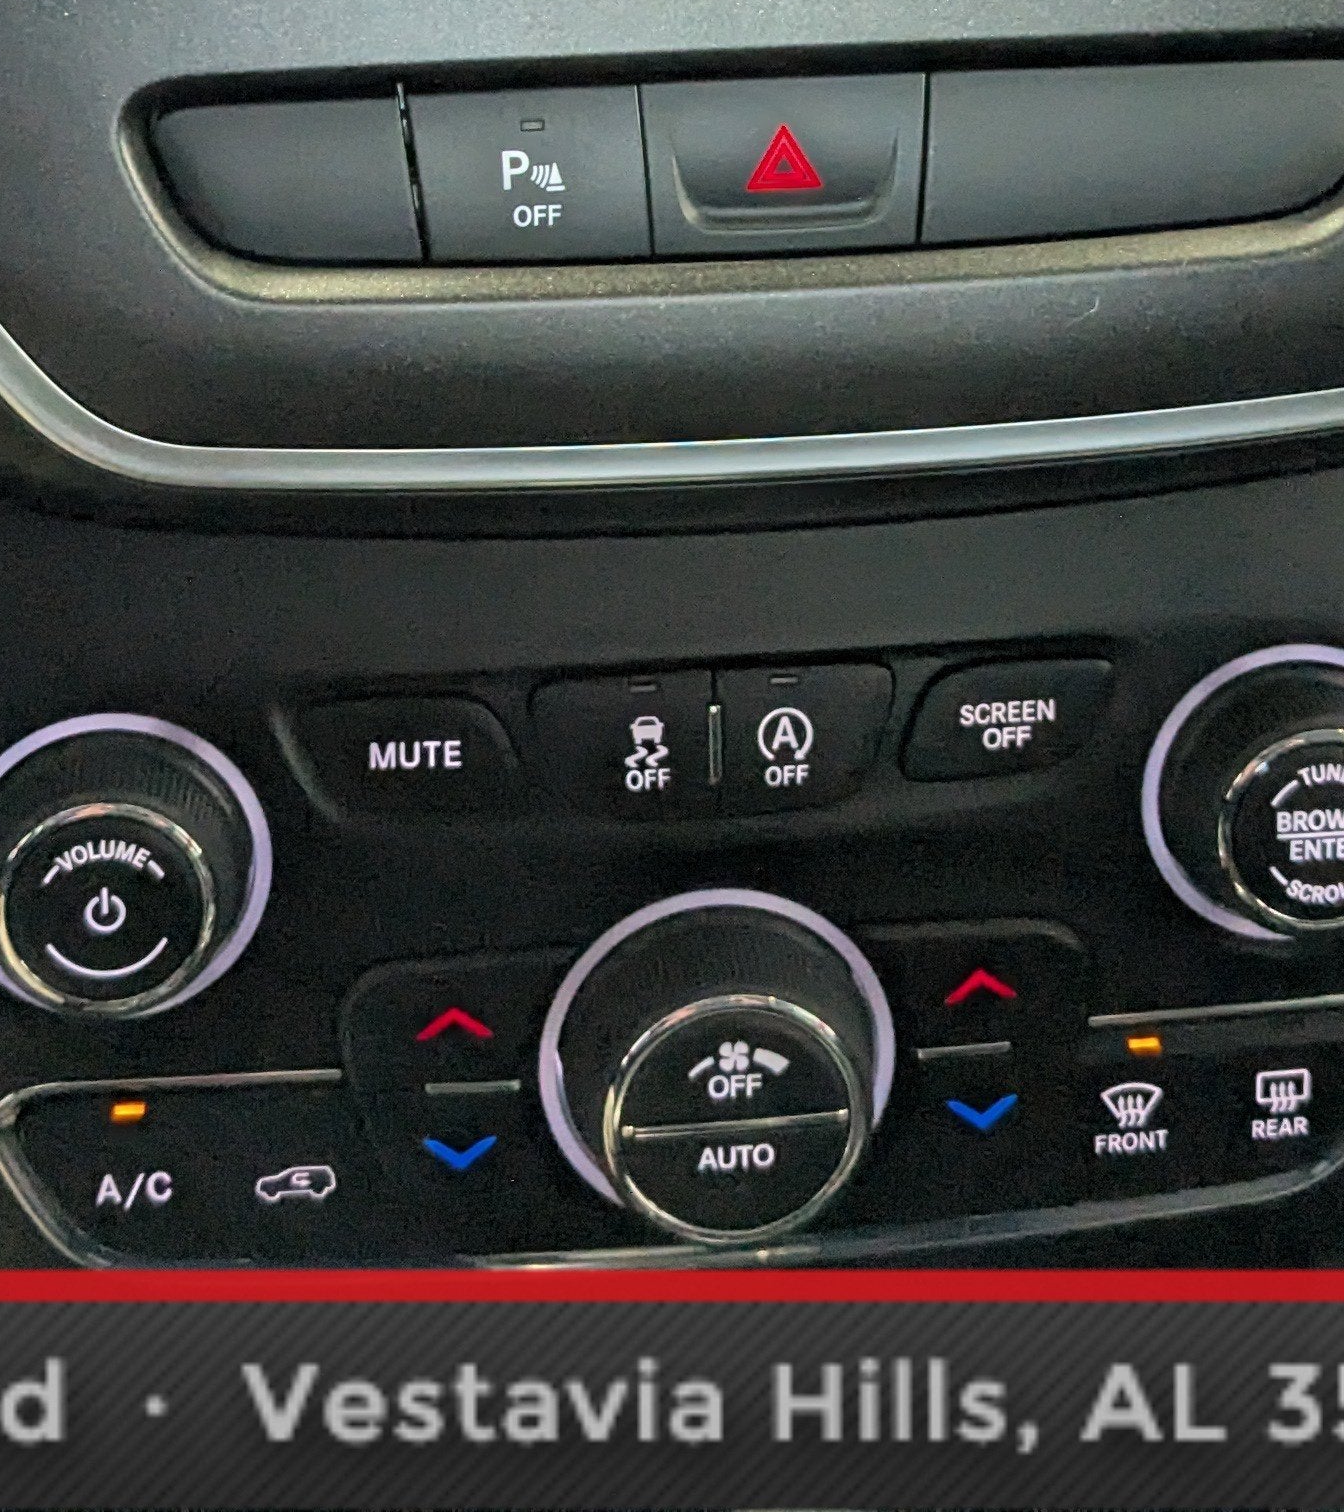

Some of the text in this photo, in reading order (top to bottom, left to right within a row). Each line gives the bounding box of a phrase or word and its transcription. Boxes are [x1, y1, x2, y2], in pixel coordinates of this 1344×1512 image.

[513, 203, 562, 228] OFF
[959, 699, 1056, 727] SCREEN
[982, 726, 1032, 750] OFF
[369, 741, 463, 770] MUTE
[625, 768, 671, 790] OFF
[764, 765, 809, 787] OFF
[56, 839, 150, 873] VOLUME
[707, 1074, 763, 1100] OFF
[1251, 1116, 1309, 1139] REAR
[1094, 1129, 1168, 1155] FRONT
[697, 1143, 776, 1171] AUTO
[96, 1172, 173, 1207] A/C
